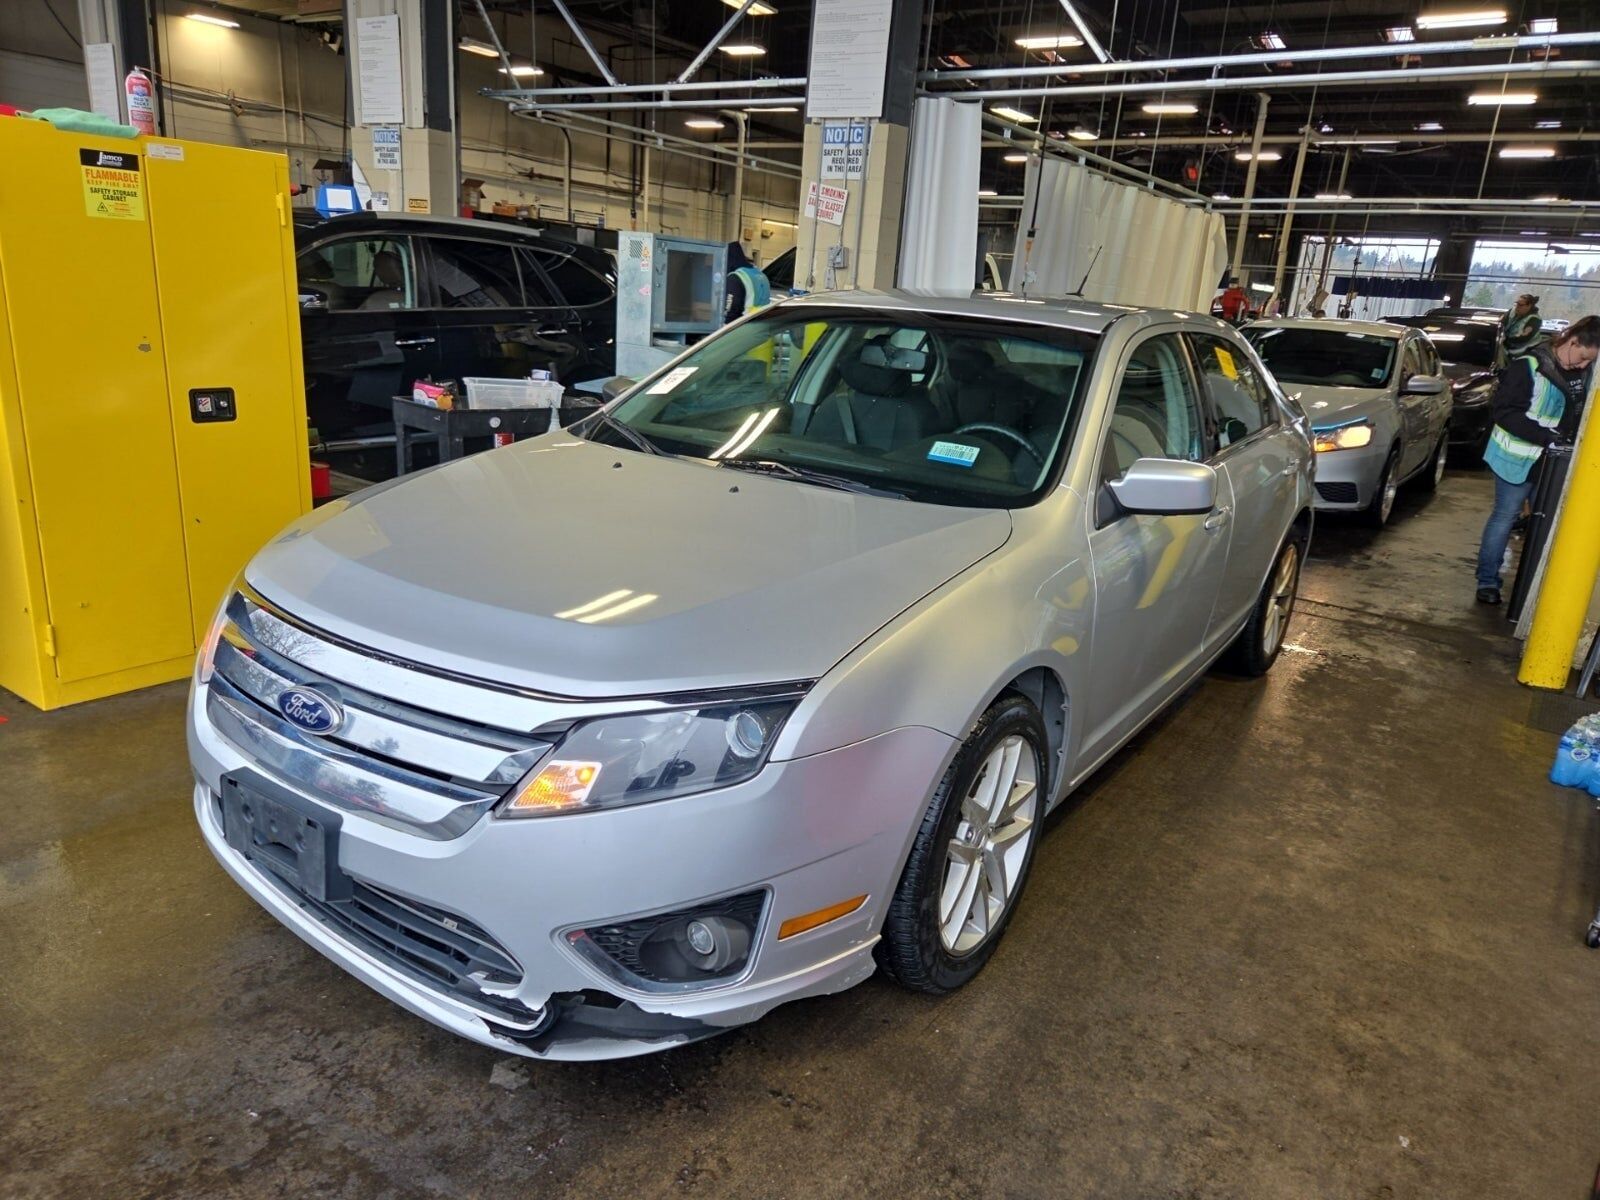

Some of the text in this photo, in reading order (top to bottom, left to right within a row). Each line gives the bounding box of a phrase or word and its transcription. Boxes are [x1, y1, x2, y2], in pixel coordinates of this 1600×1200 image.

[825, 128, 864, 142] NOTIC
[97, 152, 122, 165] Jamco
[85, 168, 139, 183] FLAMMABLE
[90, 187, 138, 198] SAFETY STORAGE
[103, 194, 127, 202] CABINET
[821, 187, 846, 200] SMOKING
[825, 201, 844, 213] GLASSES
[286, 694, 322, 725] Ford
